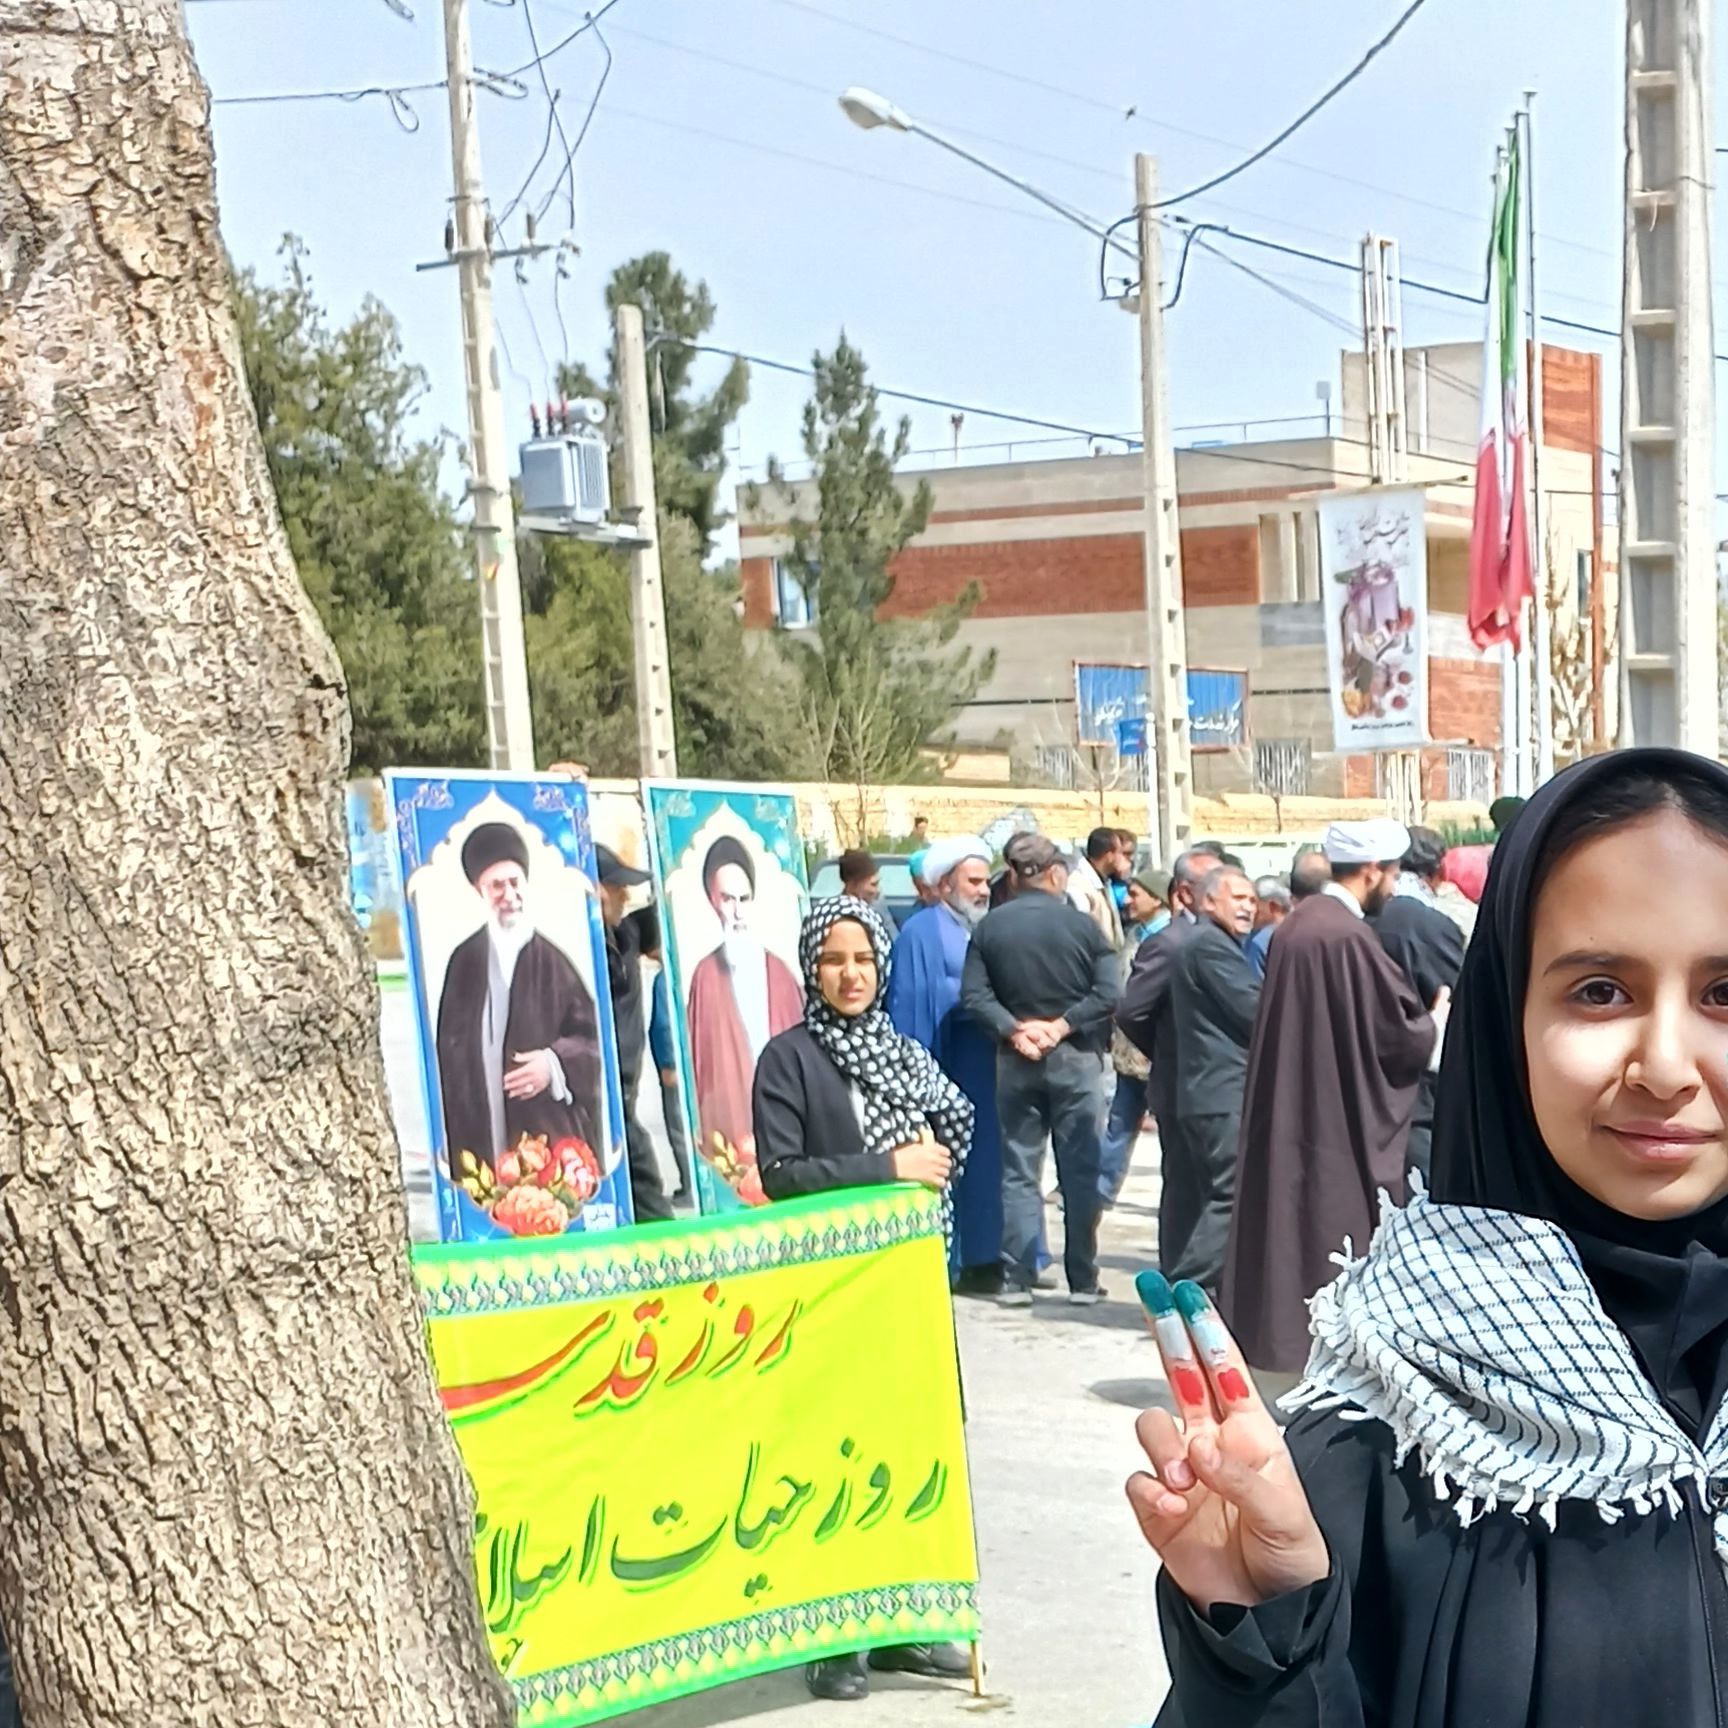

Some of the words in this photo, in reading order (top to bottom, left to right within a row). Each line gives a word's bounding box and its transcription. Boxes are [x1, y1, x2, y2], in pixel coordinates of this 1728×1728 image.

[665, 1281, 803, 1386] روز
[611, 1440, 813, 1602] حیات
[815, 1437, 946, 1542] روز
[487, 1494, 606, 1634] اسلا
